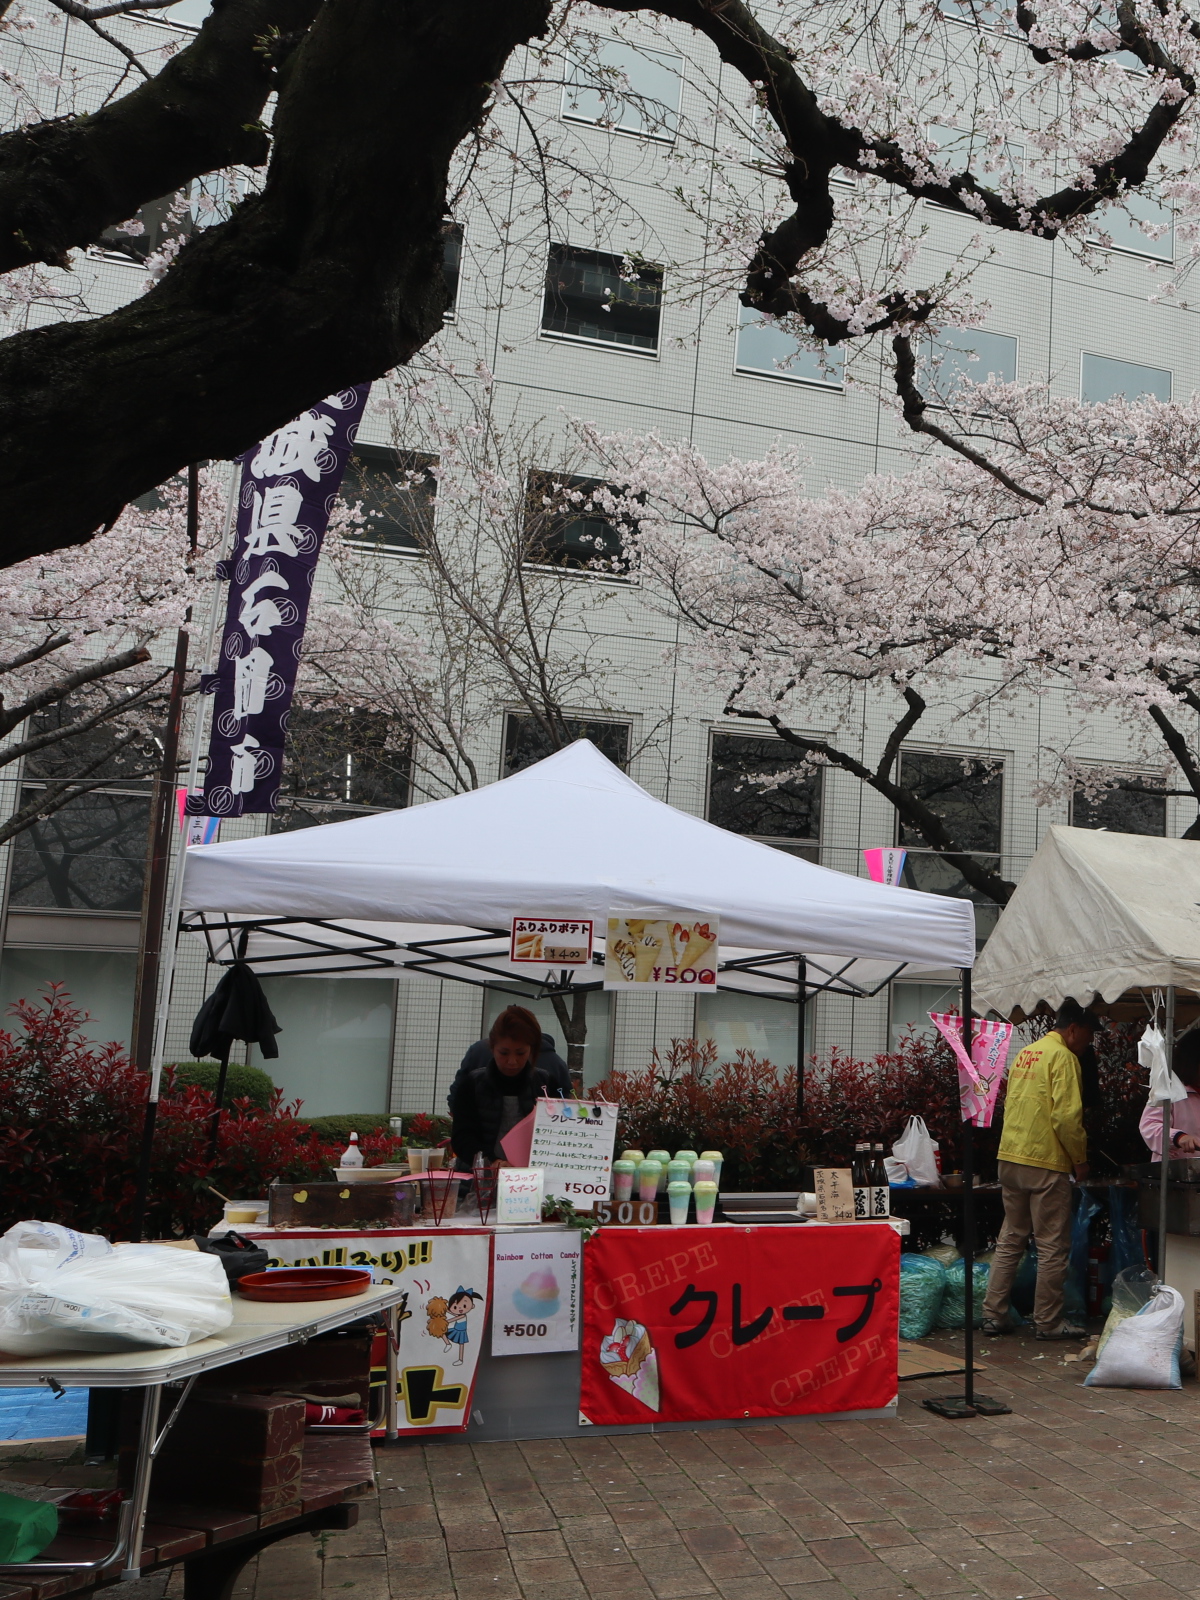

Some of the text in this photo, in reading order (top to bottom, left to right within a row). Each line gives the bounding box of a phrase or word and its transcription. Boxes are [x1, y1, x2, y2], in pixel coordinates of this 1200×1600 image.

[230, 395, 344, 795] 城県石岡市
[516, 922, 589, 934] ふりふりポテト
[550, 949, 580, 959] ¥400
[653, 966, 715, 984] ¥500
[1016, 1050, 1043, 1069] STAFF
[505, 1173, 538, 1182] スコップ
[509, 1184, 538, 1193] スプーン
[565, 1183, 606, 1195] ¥500
[597, 1201, 654, 1225] 500
[496, 1251, 580, 1261] Rainbow Cotton Candy
[593, 1241, 718, 1310] CREPE
[669, 1277, 882, 1350] クレープ
[503, 1323, 547, 1337] ¥500
[770, 1334, 886, 1408] CREPE
